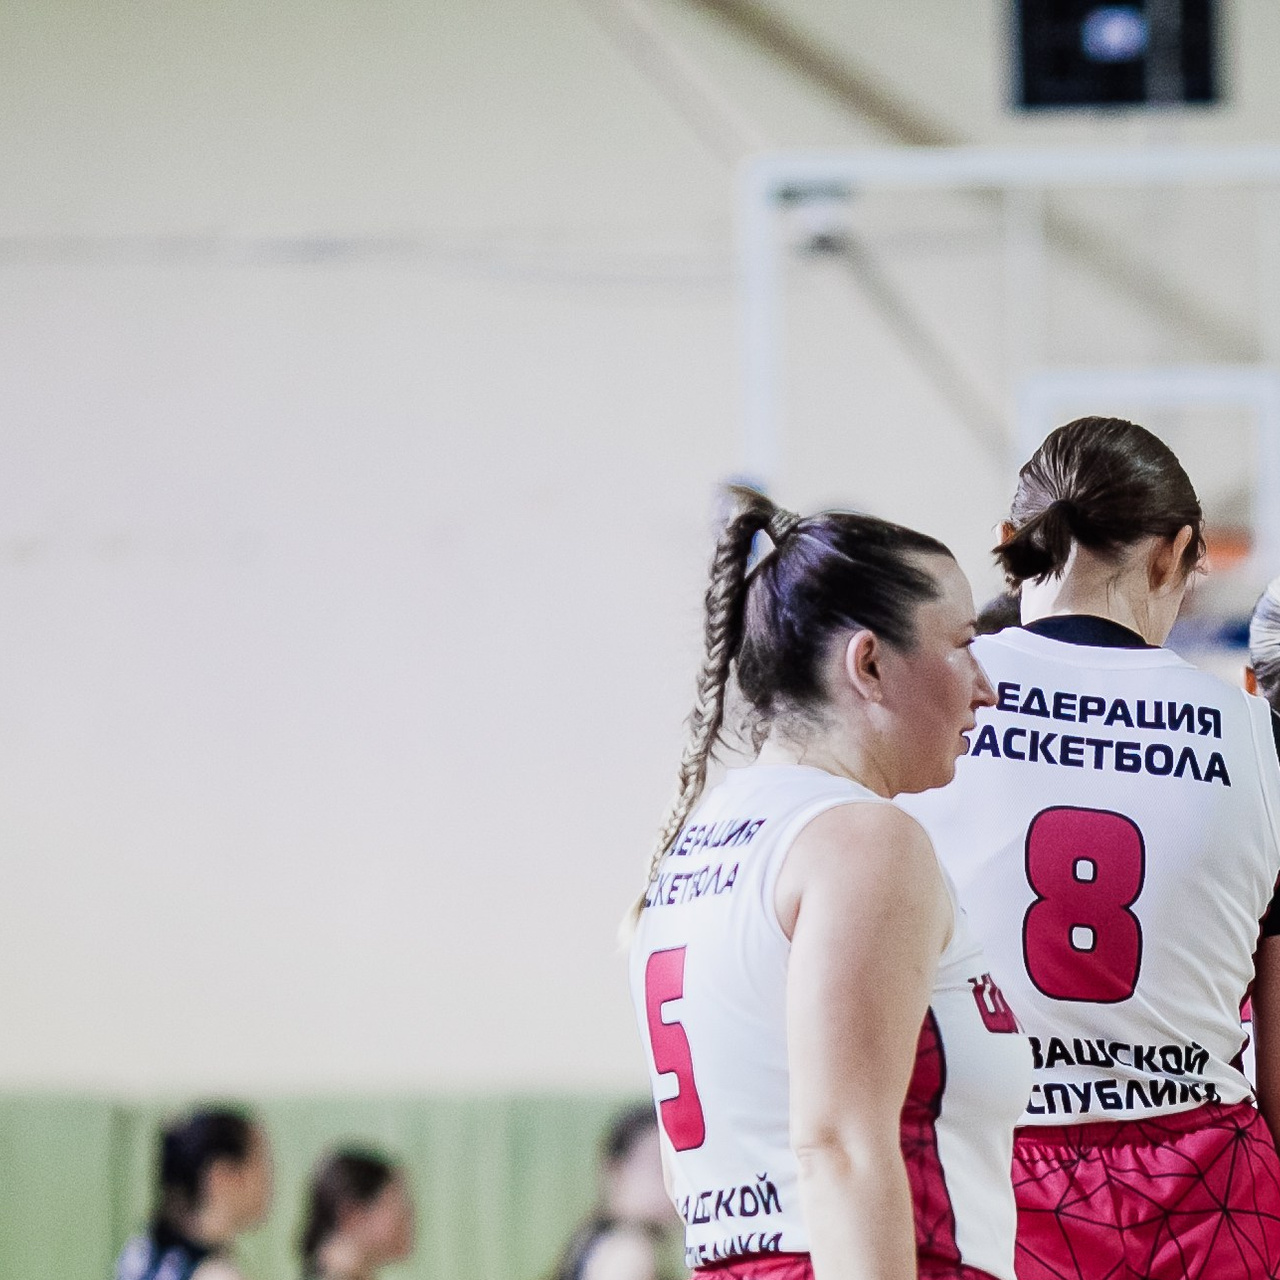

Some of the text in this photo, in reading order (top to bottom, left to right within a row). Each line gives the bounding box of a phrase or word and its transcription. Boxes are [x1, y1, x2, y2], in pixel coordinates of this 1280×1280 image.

[961, 724, 1232, 788] АСКЕТБОЛА
[996, 681, 1222, 739] ЕДЕРАЦИЯ
[1022, 805, 1146, 1005] 8
[645, 944, 706, 1153] 5
